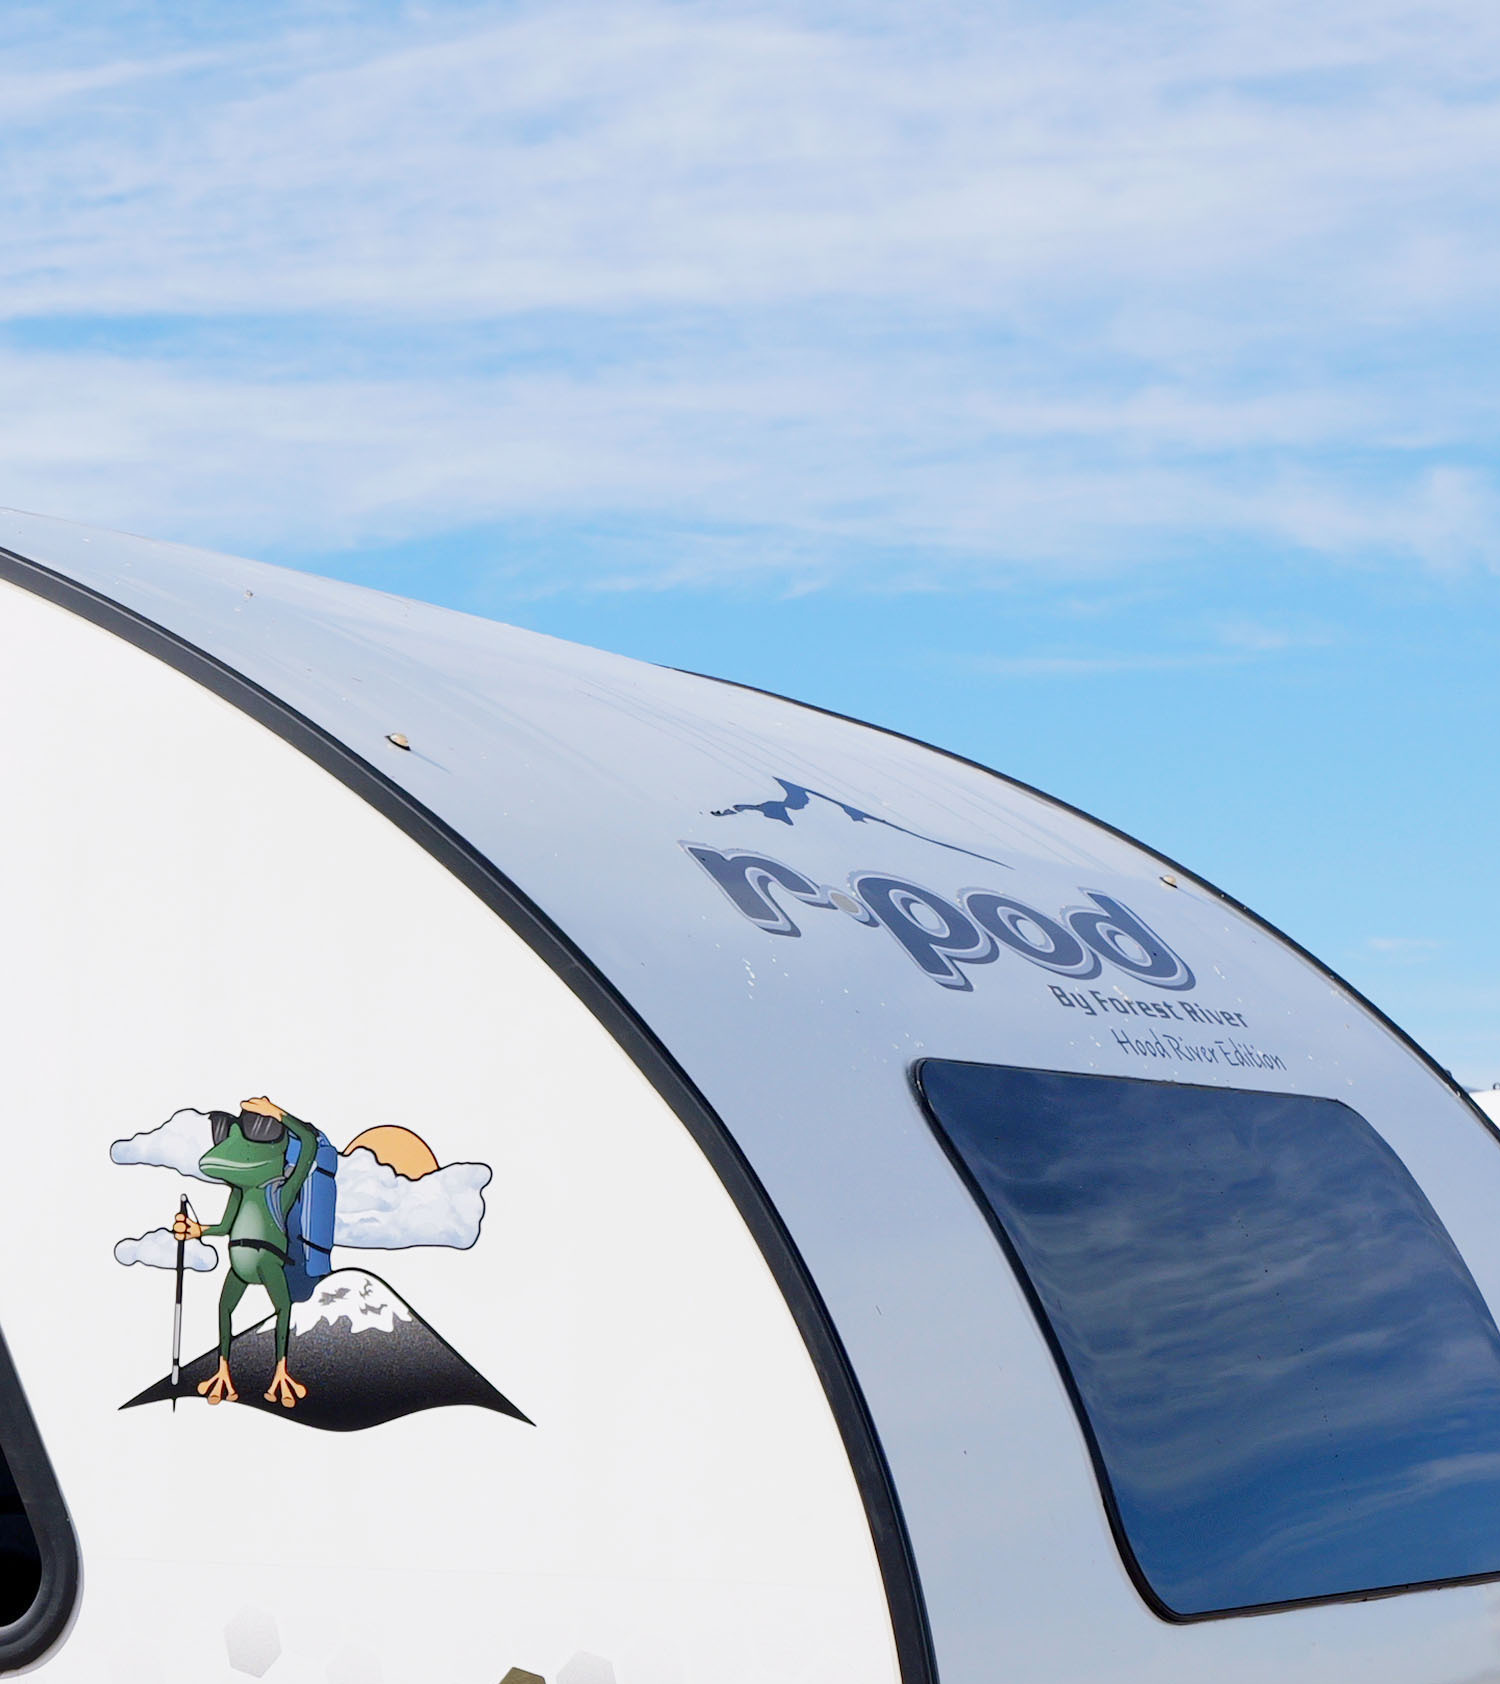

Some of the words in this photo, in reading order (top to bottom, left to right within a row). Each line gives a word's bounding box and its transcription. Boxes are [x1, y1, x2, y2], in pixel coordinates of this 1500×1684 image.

[1047, 984, 1098, 1016] By
[1089, 990, 1184, 1021] Forest
[1178, 1000, 1249, 1029] River
[1111, 1028, 1170, 1059] Hood
[1162, 1034, 1220, 1064] River
[1214, 1038, 1288, 1072] Edition
